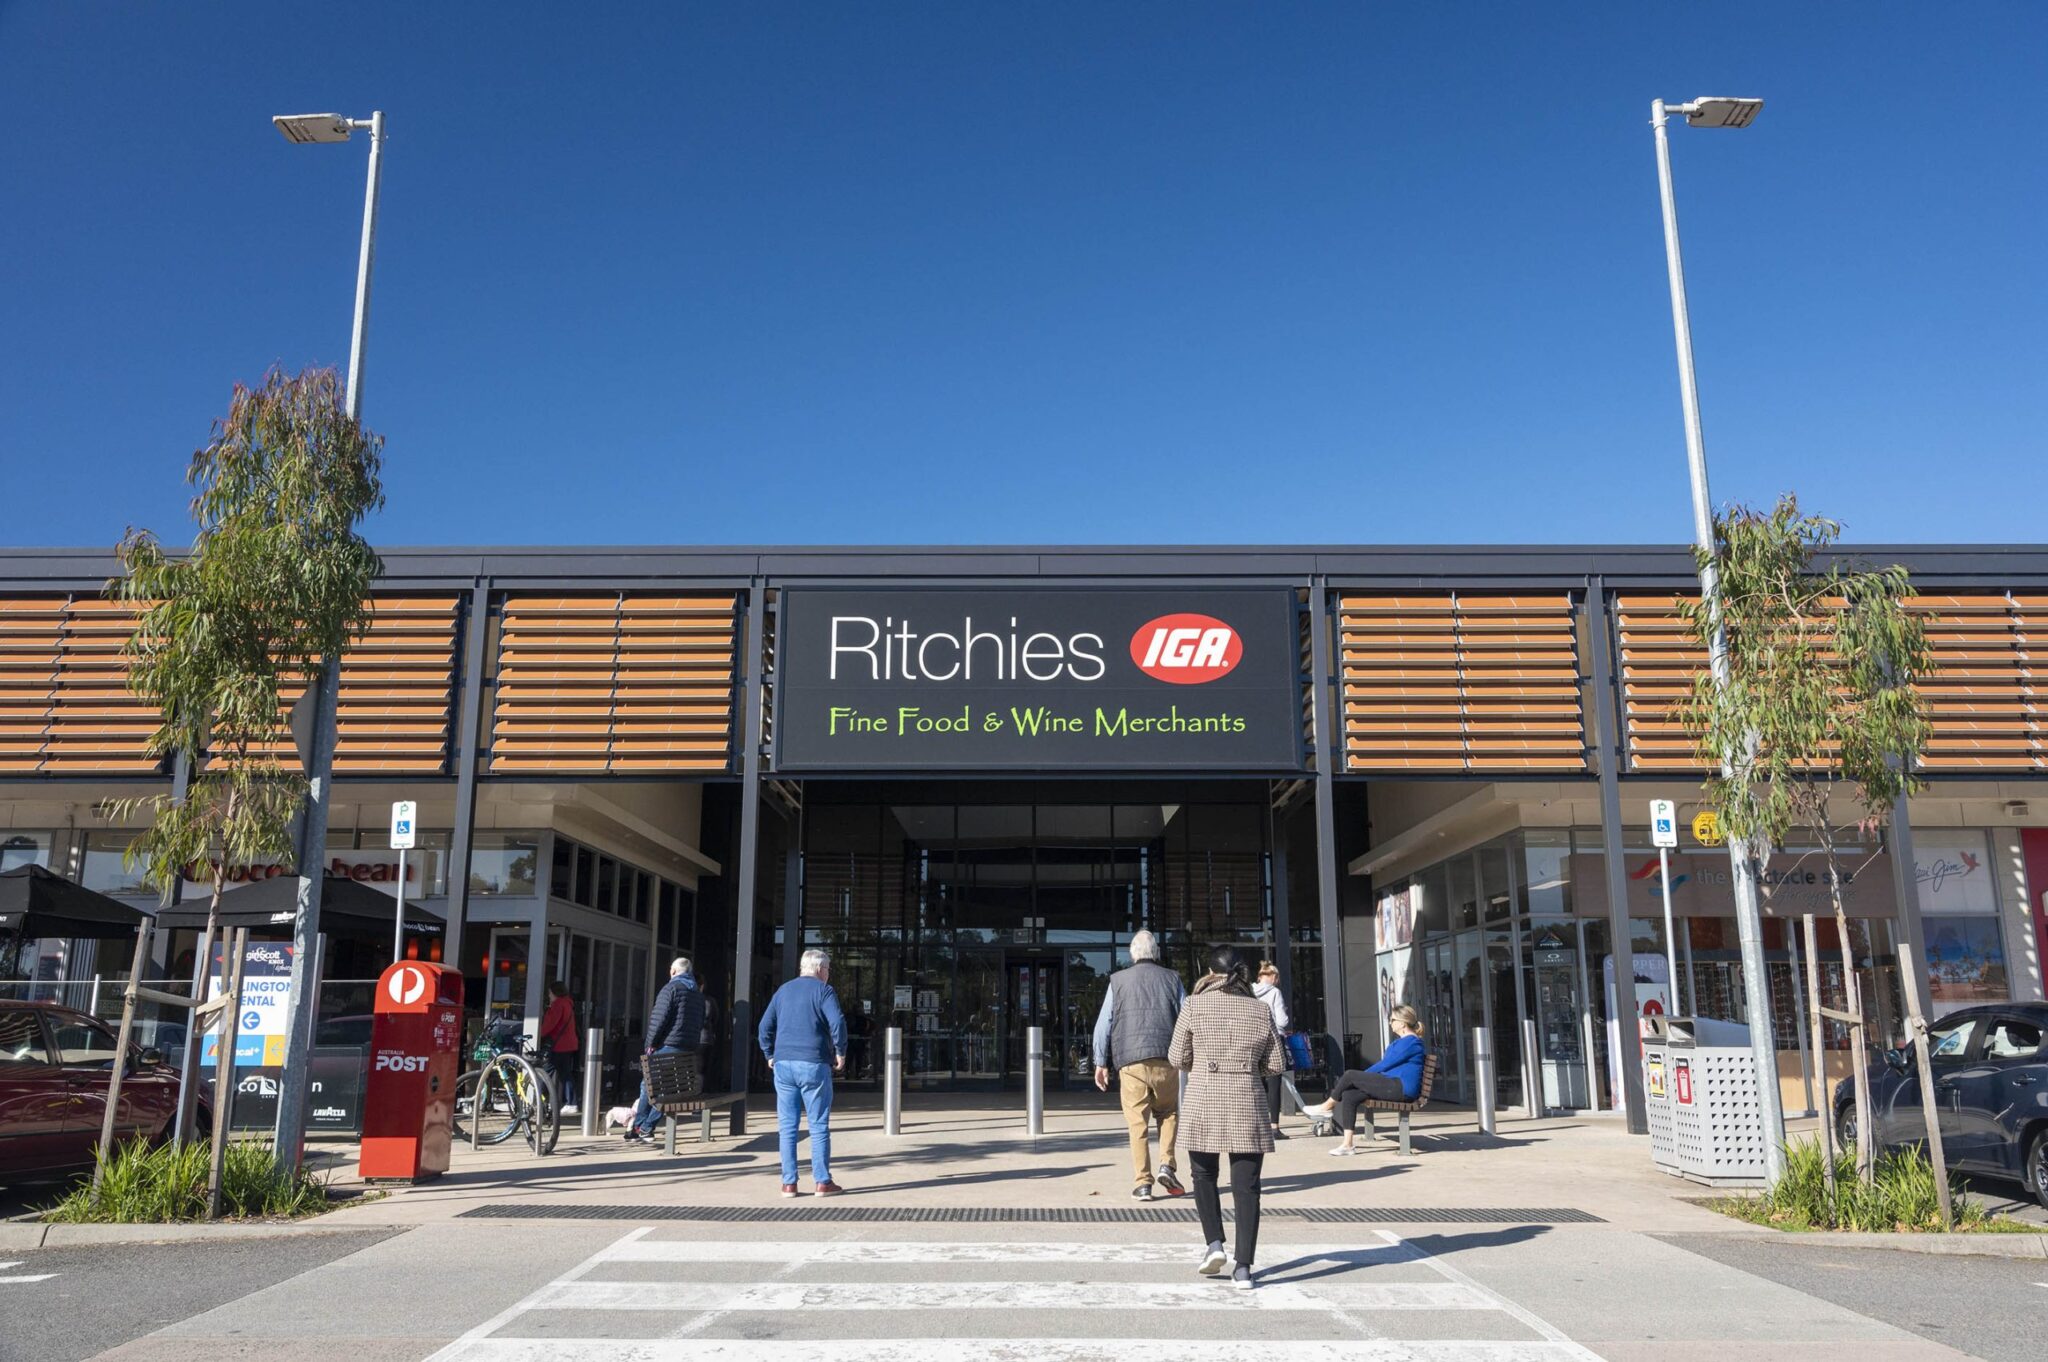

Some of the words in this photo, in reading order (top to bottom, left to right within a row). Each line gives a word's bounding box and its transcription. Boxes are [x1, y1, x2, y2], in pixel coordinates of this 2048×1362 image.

[830, 616, 1107, 681] Ritchies
[830, 707, 887, 735] Fine
[898, 706, 970, 735] Food
[983, 716, 1002, 732] &
[1011, 708, 1084, 735] Wine
[1095, 706, 1247, 736] Merchants
[1697, 868, 1727, 885] the
[1822, 869, 1854, 885] ste
[241, 995, 276, 1006] ENTAL
[375, 1055, 430, 1072] POST
[313, 1107, 346, 1117] LAVAZZA
